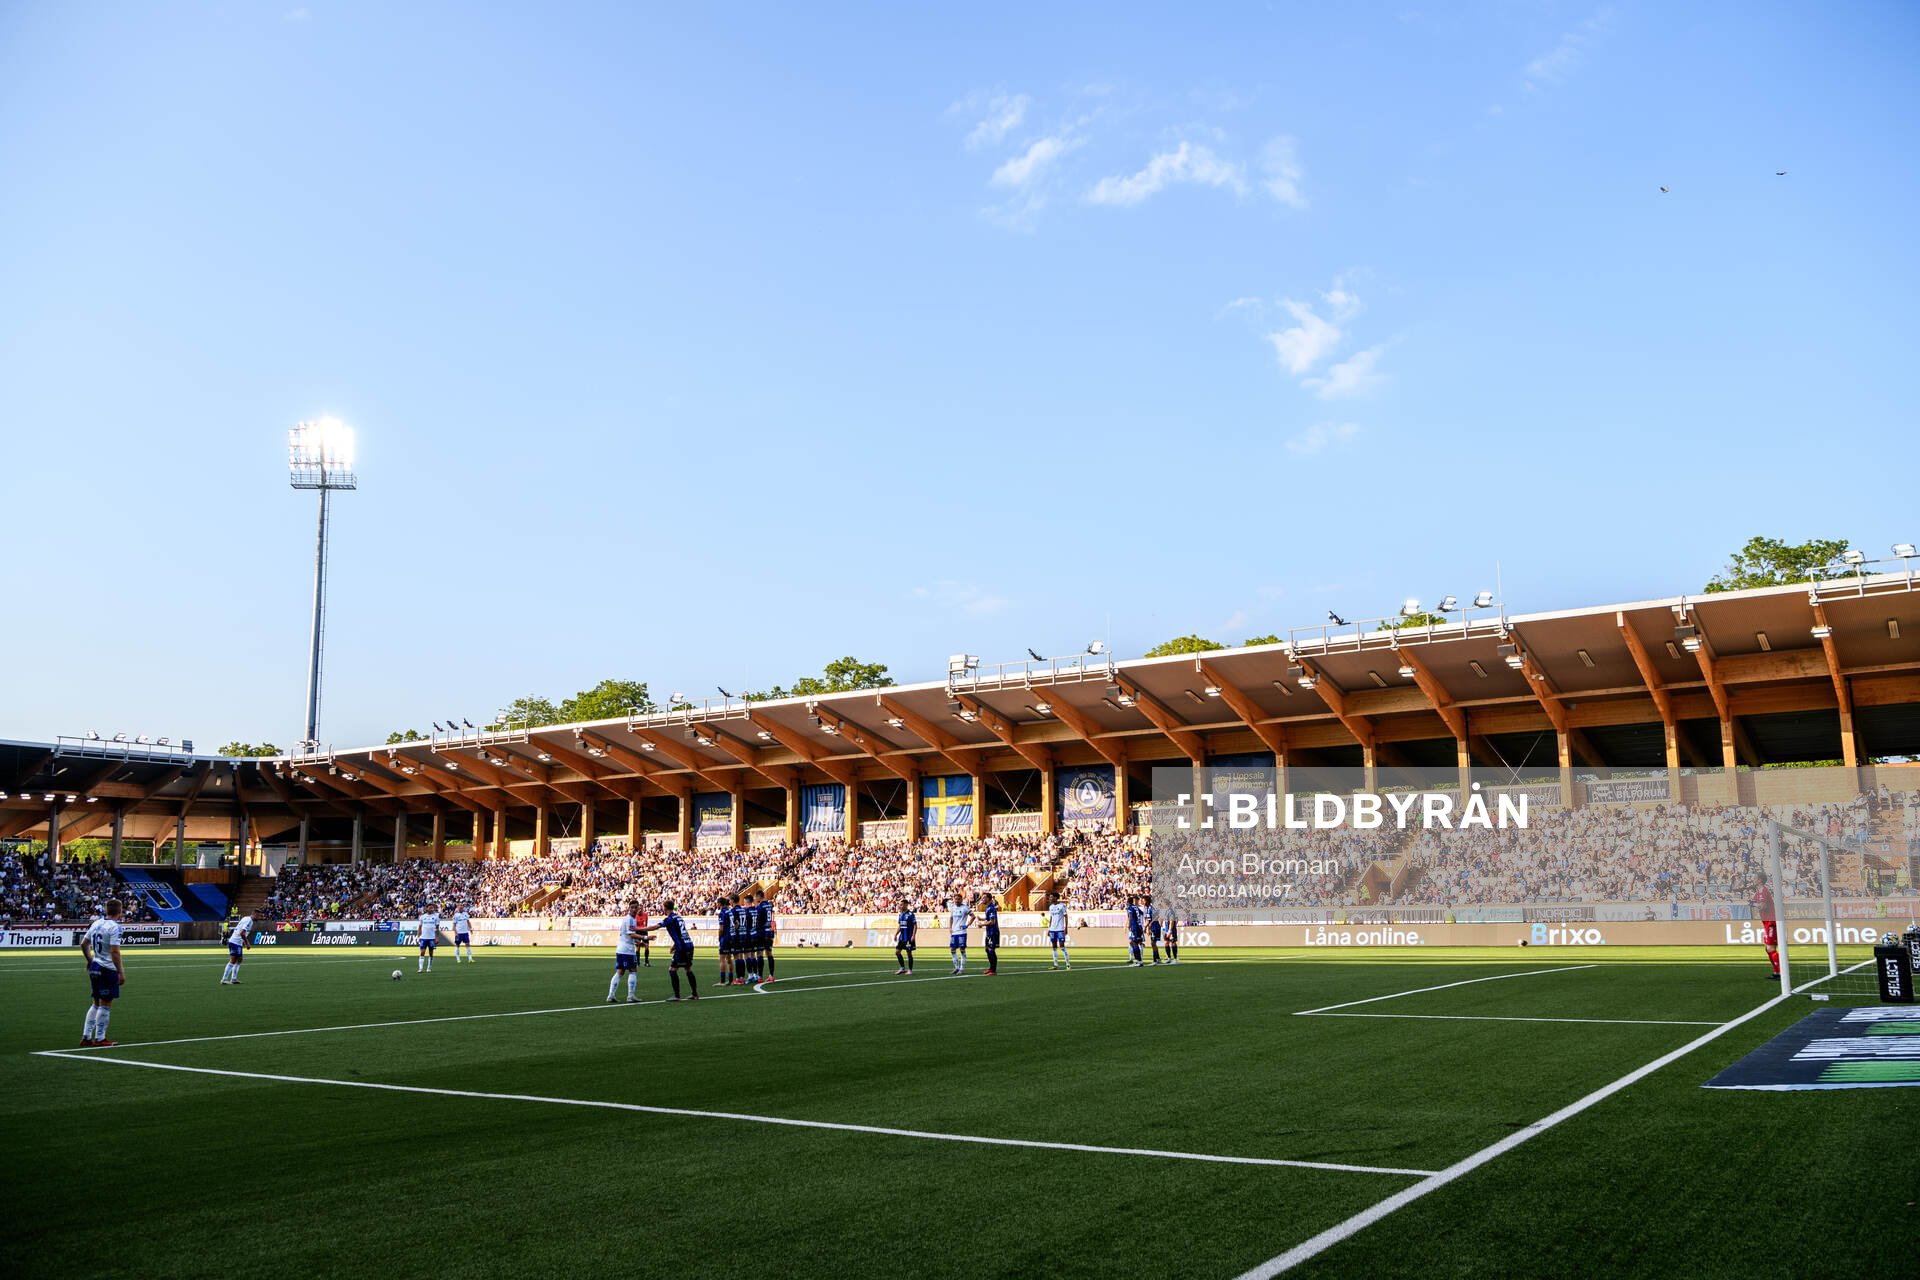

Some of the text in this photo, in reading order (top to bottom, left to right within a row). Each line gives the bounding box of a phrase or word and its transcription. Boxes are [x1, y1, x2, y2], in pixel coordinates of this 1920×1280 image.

[1616, 788, 1667, 800] BILFORUM
[9, 933, 63, 945] Thermia
[127, 935, 155, 944] System
[311, 932, 331, 945] Låna
[397, 932, 420, 945] Brix
[1305, 927, 1351, 945] Låna
[1726, 922, 1765, 944] Lån
[1793, 922, 1878, 944] onine
[1885, 959, 1901, 997] SELECT
